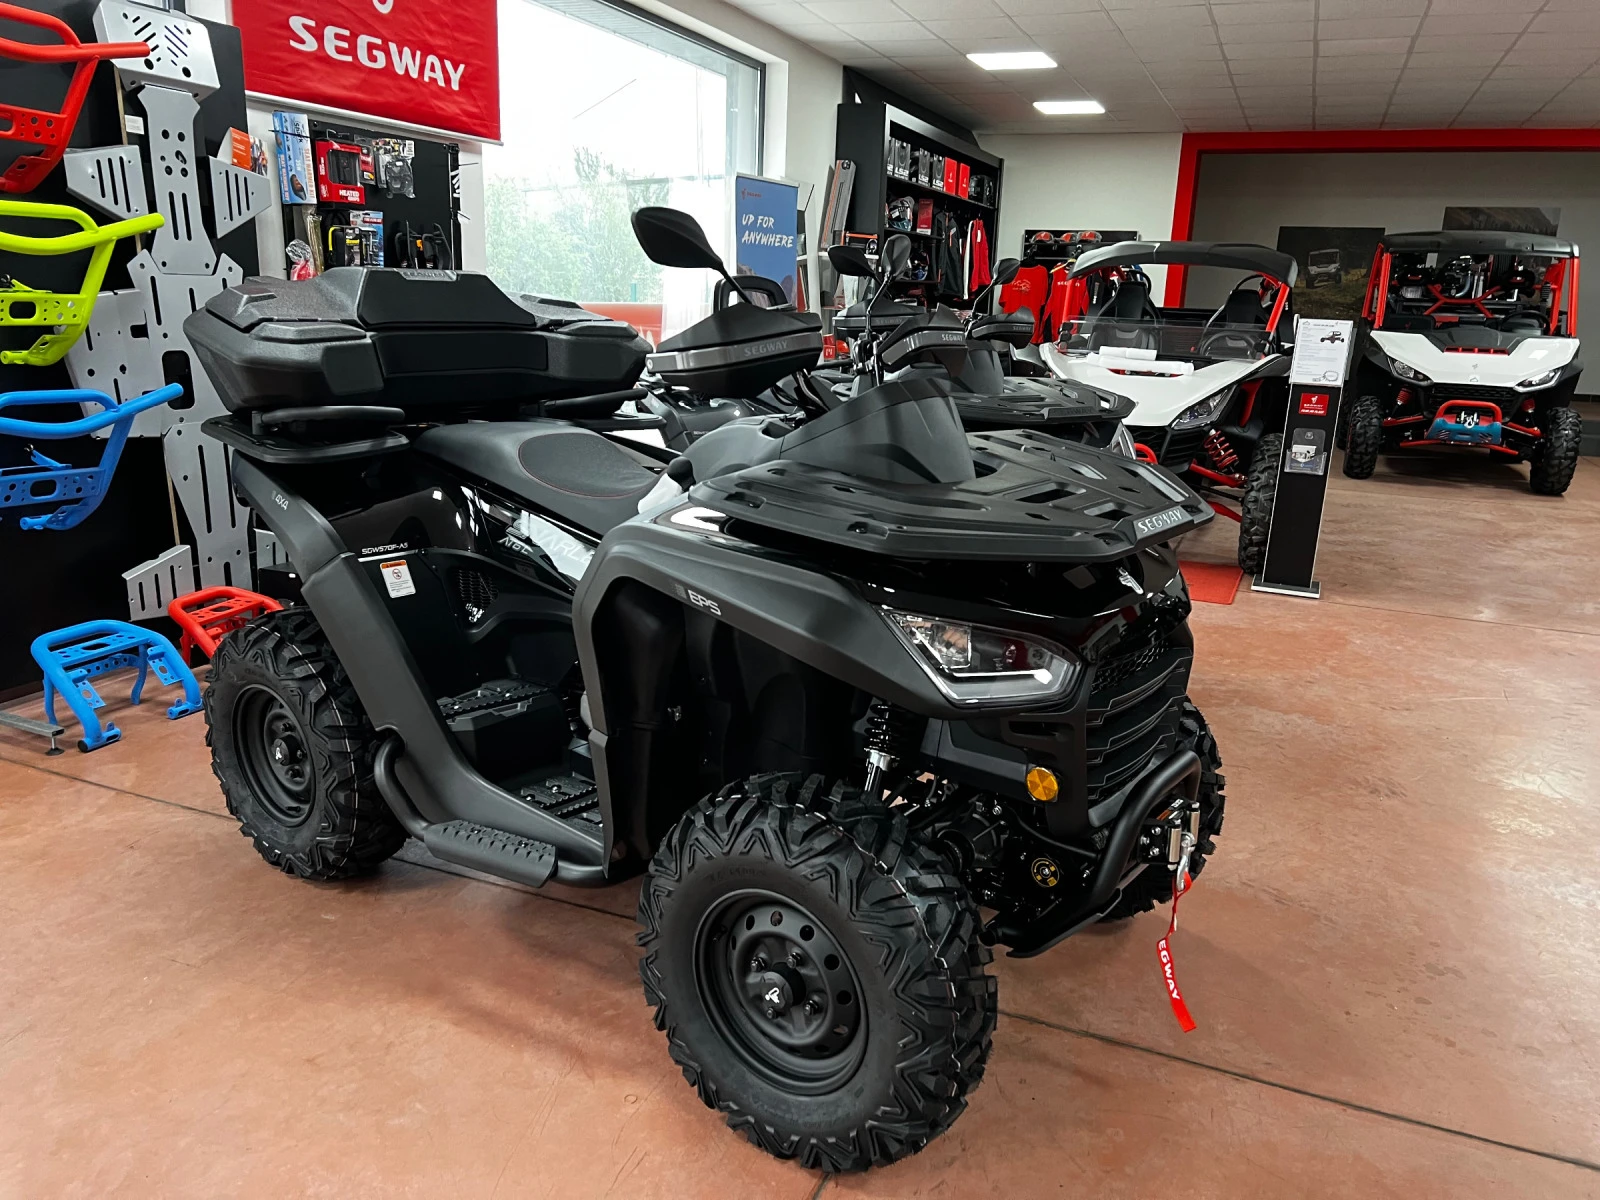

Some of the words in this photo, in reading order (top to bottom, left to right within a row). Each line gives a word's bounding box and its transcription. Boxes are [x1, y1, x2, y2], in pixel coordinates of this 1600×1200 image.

[288, 15, 465, 91] SEGWAY
[894, 166, 909, 176] LS2
[742, 214, 754, 226] UP
[757, 216, 775, 229] FOR
[742, 230, 794, 248] ANYWHERE
[941, 333, 963, 342] SEGWAY
[743, 340, 788, 357] SEGWAY
[1137, 508, 1183, 534] SEGWAY
[687, 589, 722, 616] EPS
